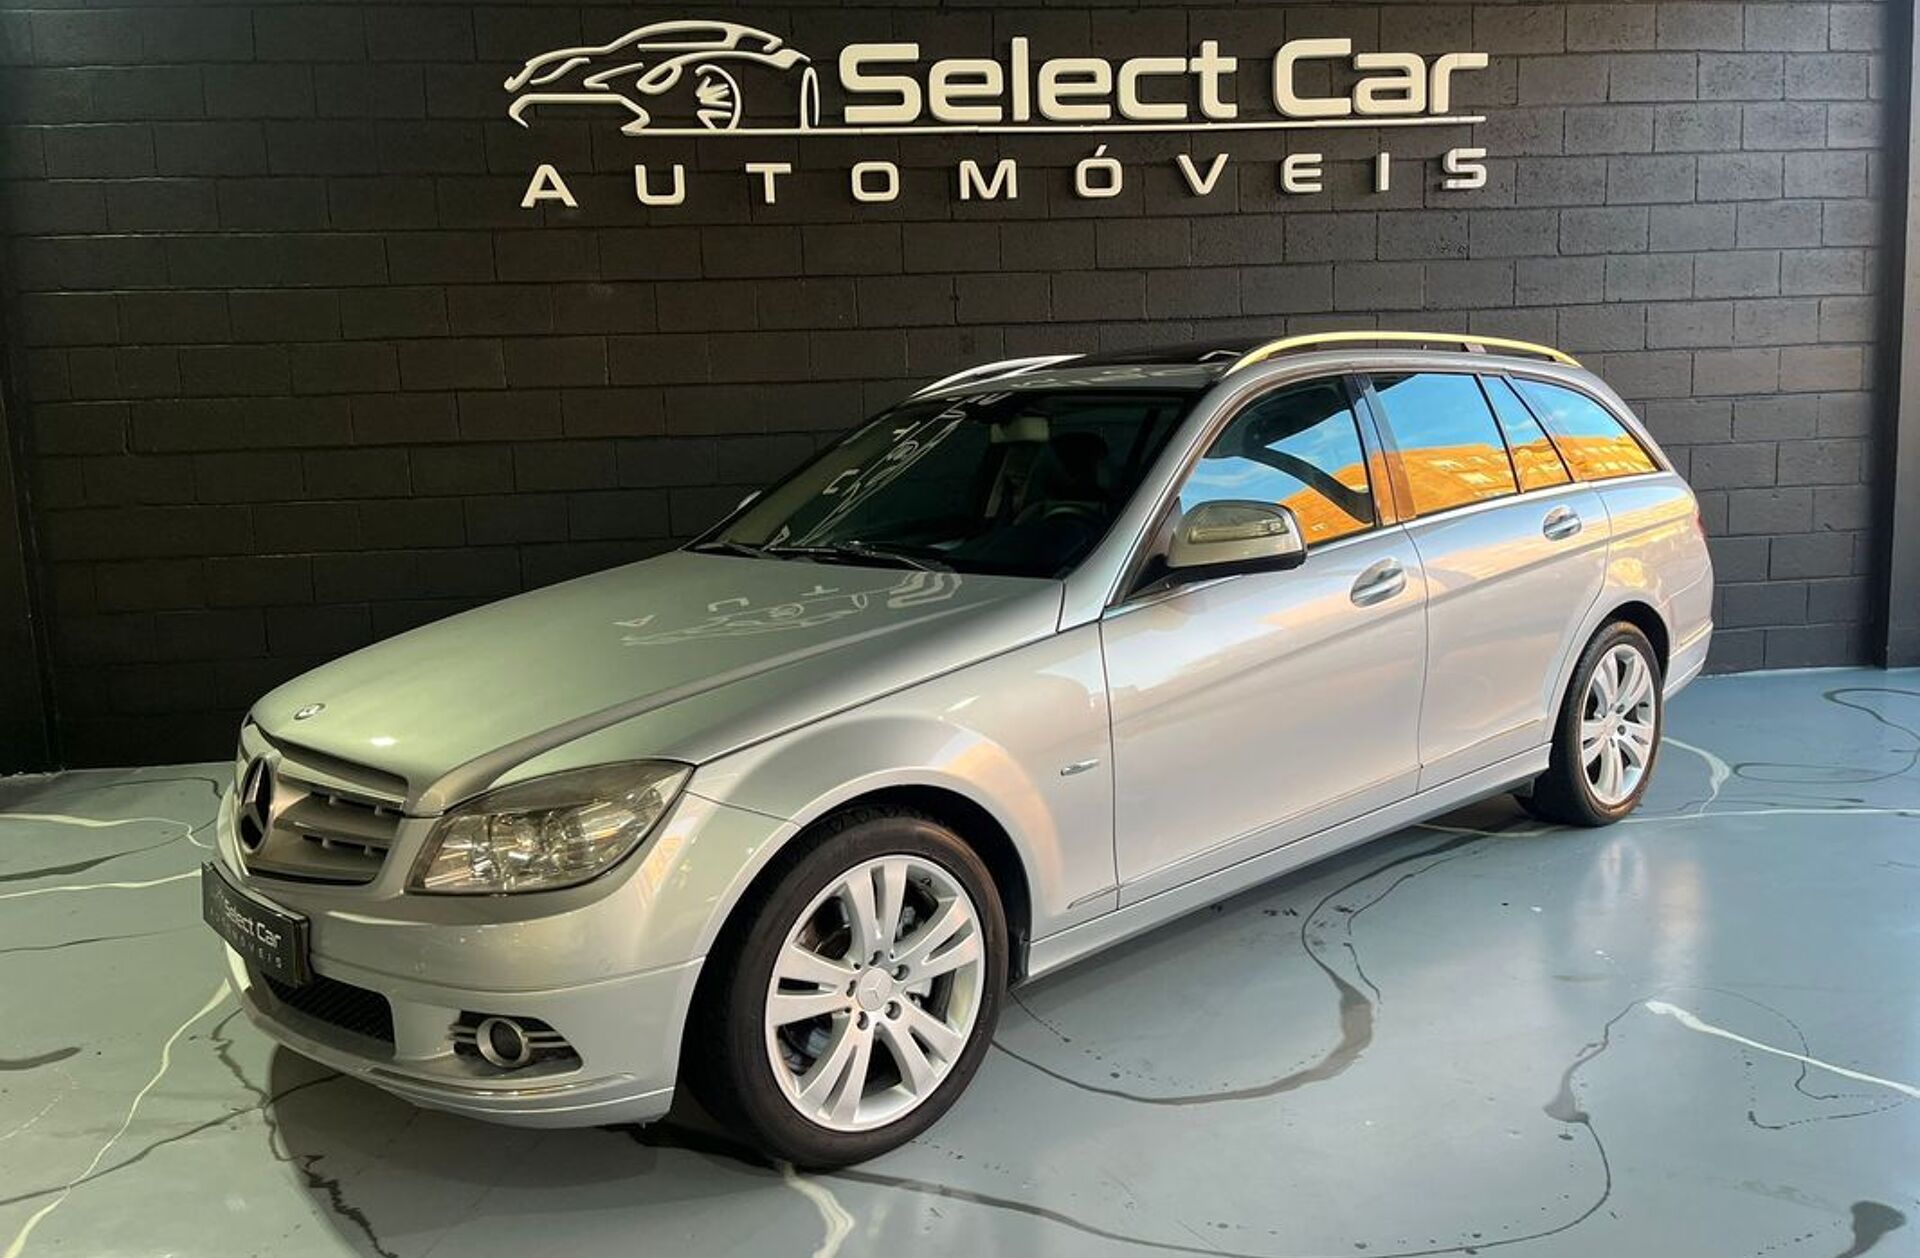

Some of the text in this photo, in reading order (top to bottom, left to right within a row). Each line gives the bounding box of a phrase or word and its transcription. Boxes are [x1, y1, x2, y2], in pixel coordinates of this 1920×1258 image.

[839, 37, 1489, 124] Select Car
[521, 145, 1487, 208] AUTOMÓVEIS
[209, 906, 282, 969] AMVEIS
[224, 898, 282, 948] Select Car
